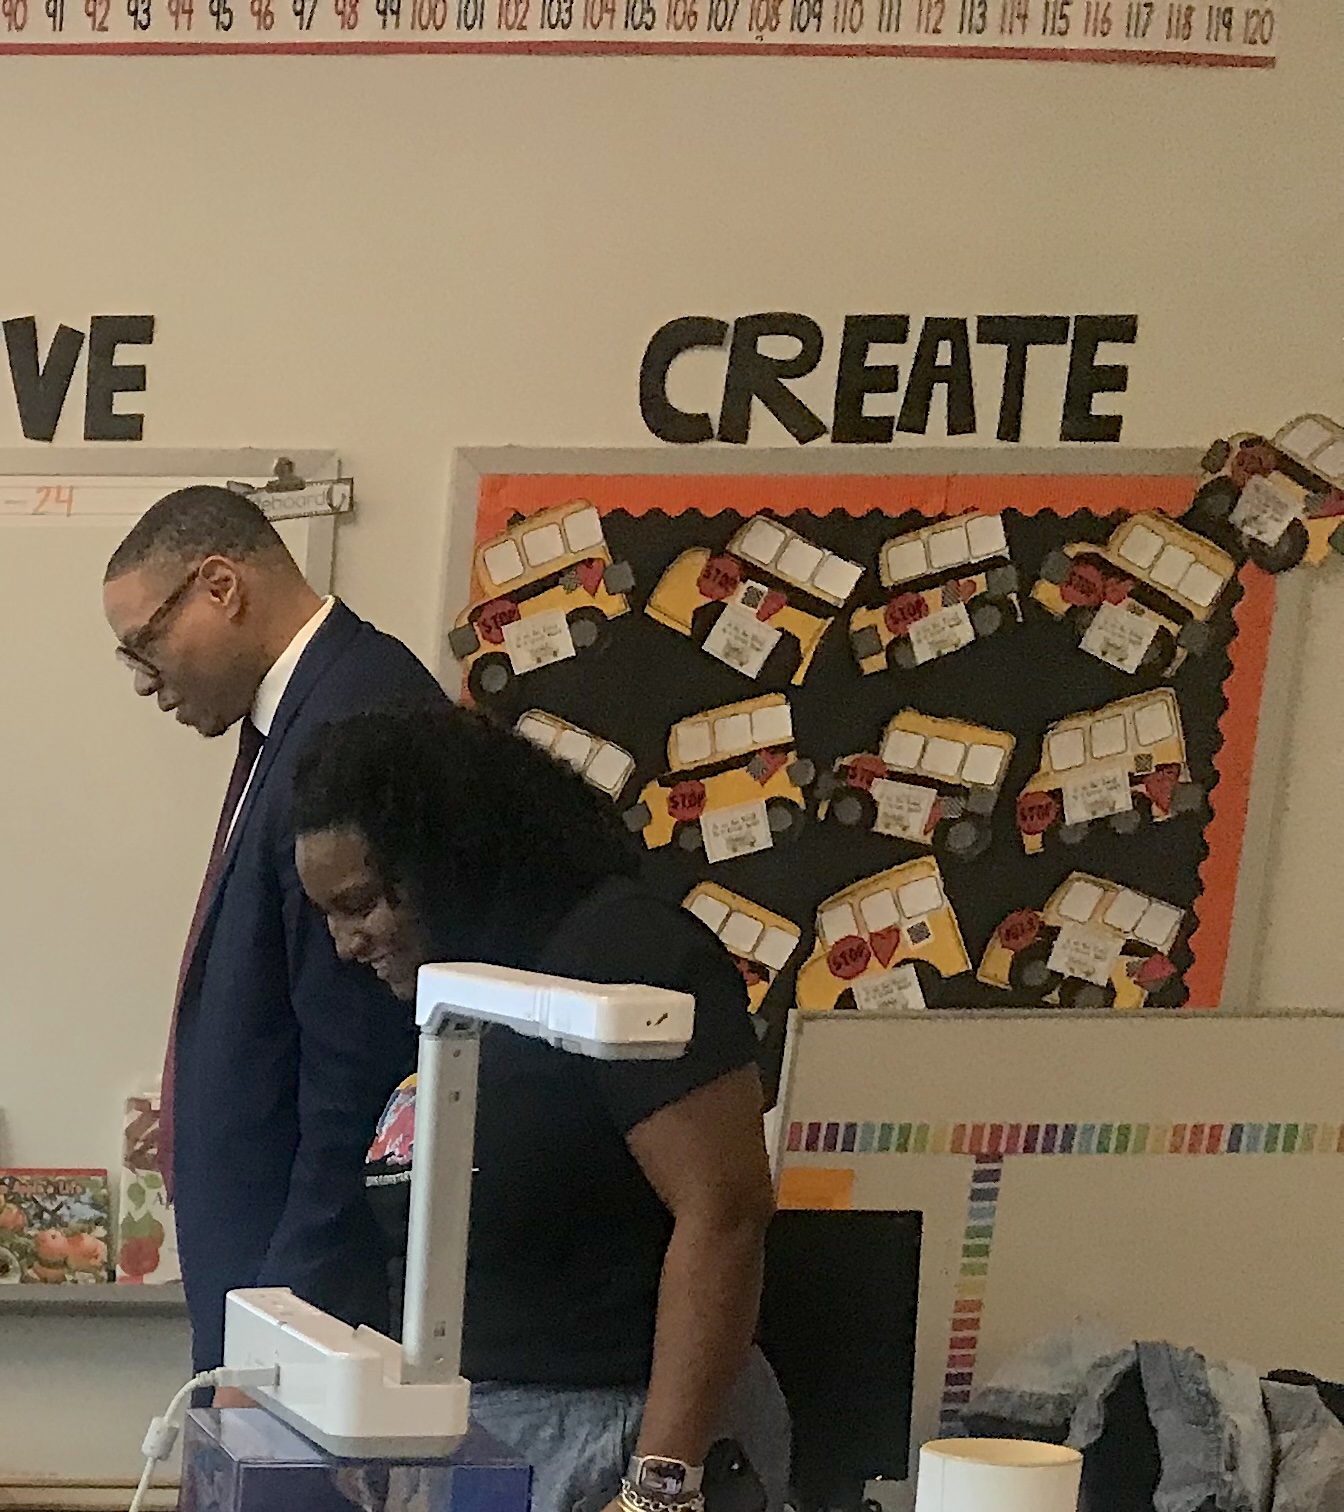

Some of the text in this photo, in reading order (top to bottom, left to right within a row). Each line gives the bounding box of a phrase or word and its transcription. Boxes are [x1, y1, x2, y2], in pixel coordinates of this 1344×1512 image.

[957, 0, 987, 34] 113
[1041, 1, 1072, 36] 115
[1166, 3, 1195, 40] 118
[1206, 5, 1233, 42] 119
[1243, 8, 1274, 45] 120
[638, 311, 1138, 445] CREATE
